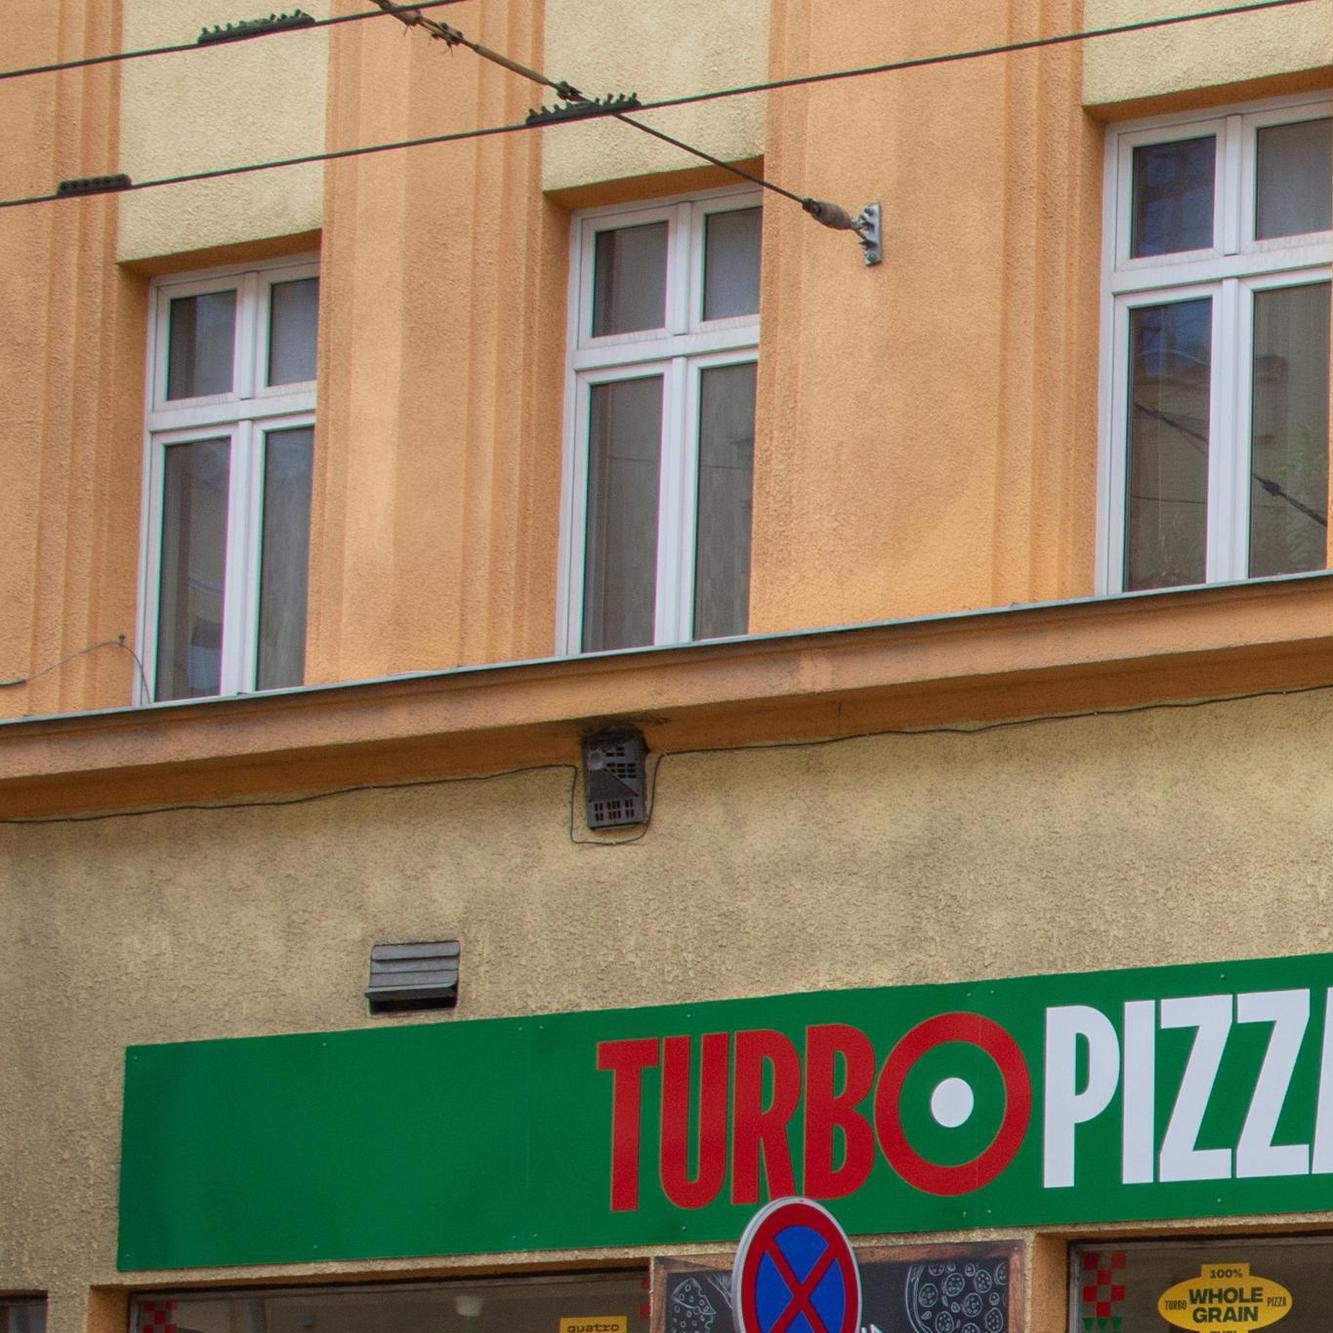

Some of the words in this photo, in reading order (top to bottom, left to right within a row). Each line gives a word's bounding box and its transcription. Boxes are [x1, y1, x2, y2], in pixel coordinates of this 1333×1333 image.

[596, 1010, 1032, 1212] TURBO
[1209, 1268, 1243, 1279] 100%
[1165, 1299, 1187, 1311] TURBO
[1188, 1287, 1264, 1305] WHOLE
[1266, 1296, 1287, 1307] PIZZA
[1192, 1306, 1259, 1324] GRAIN
